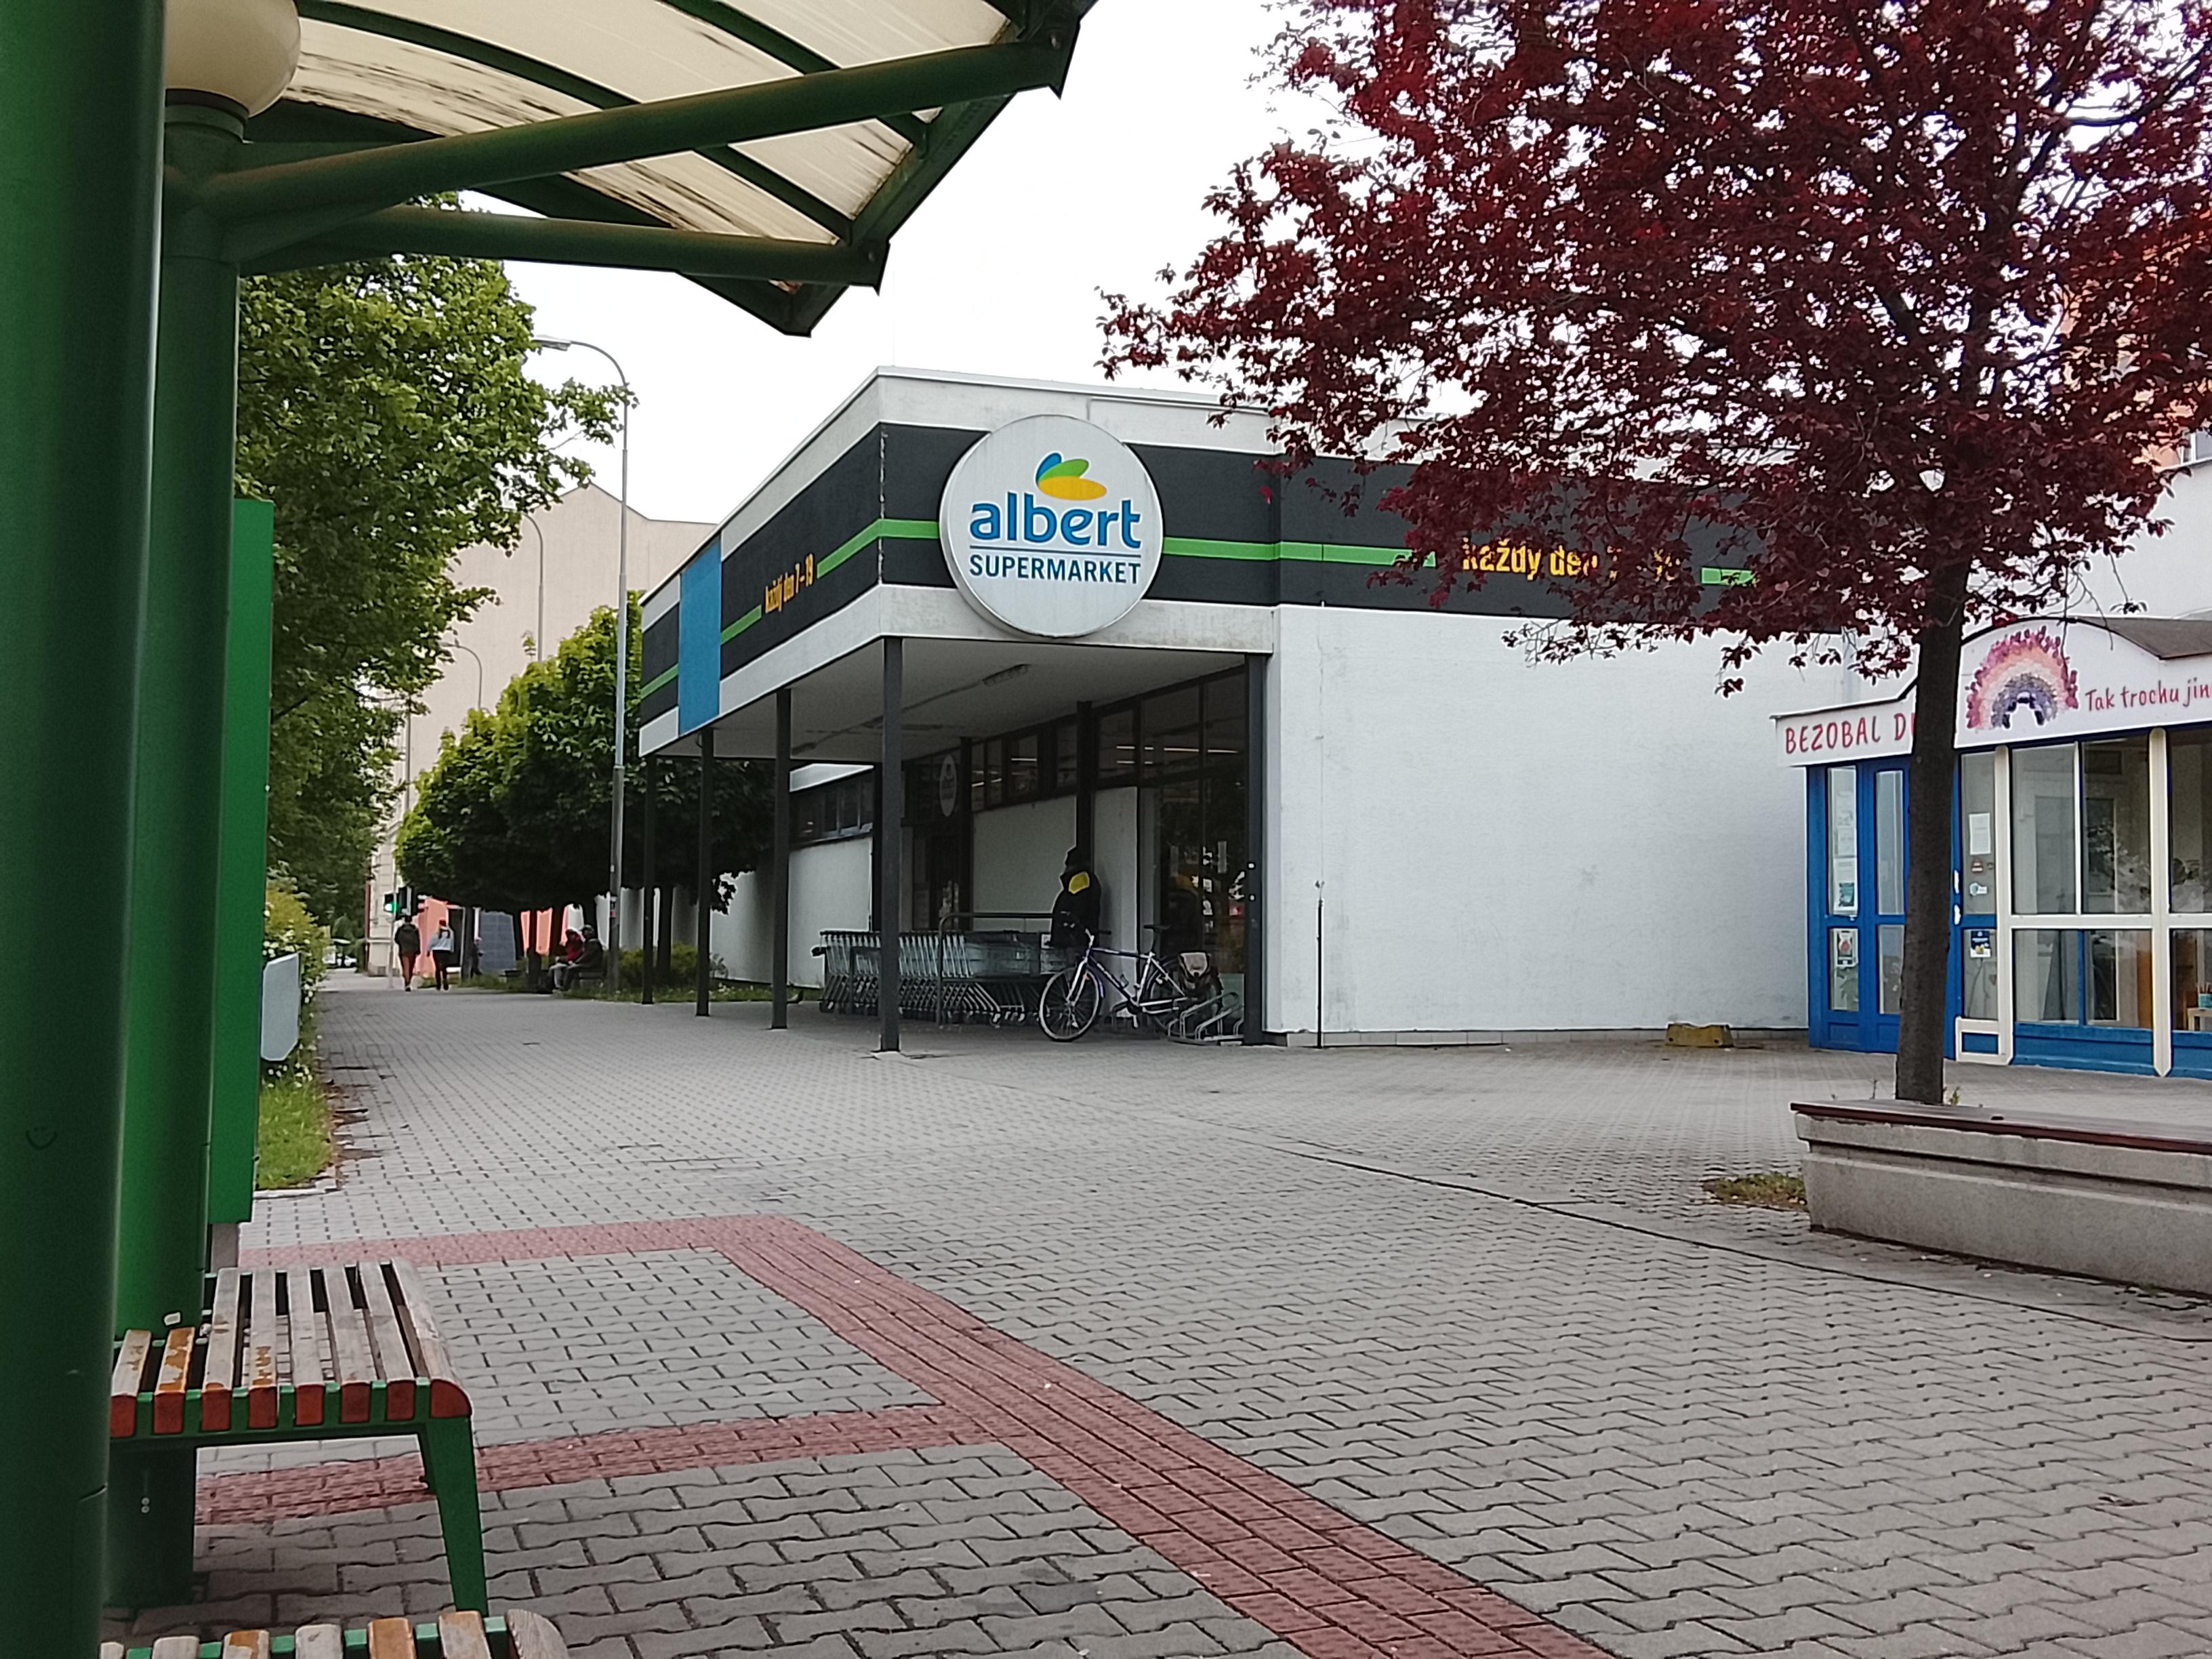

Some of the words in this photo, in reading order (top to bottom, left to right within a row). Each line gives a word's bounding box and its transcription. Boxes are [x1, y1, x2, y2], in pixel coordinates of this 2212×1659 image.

[969, 491, 1141, 550] albert
[969, 554, 1141, 584] SUPERMARKET
[2085, 687, 2115, 712] Tak
[2120, 680, 2179, 708] trochu
[1785, 715, 1881, 754] BEZOBAL
